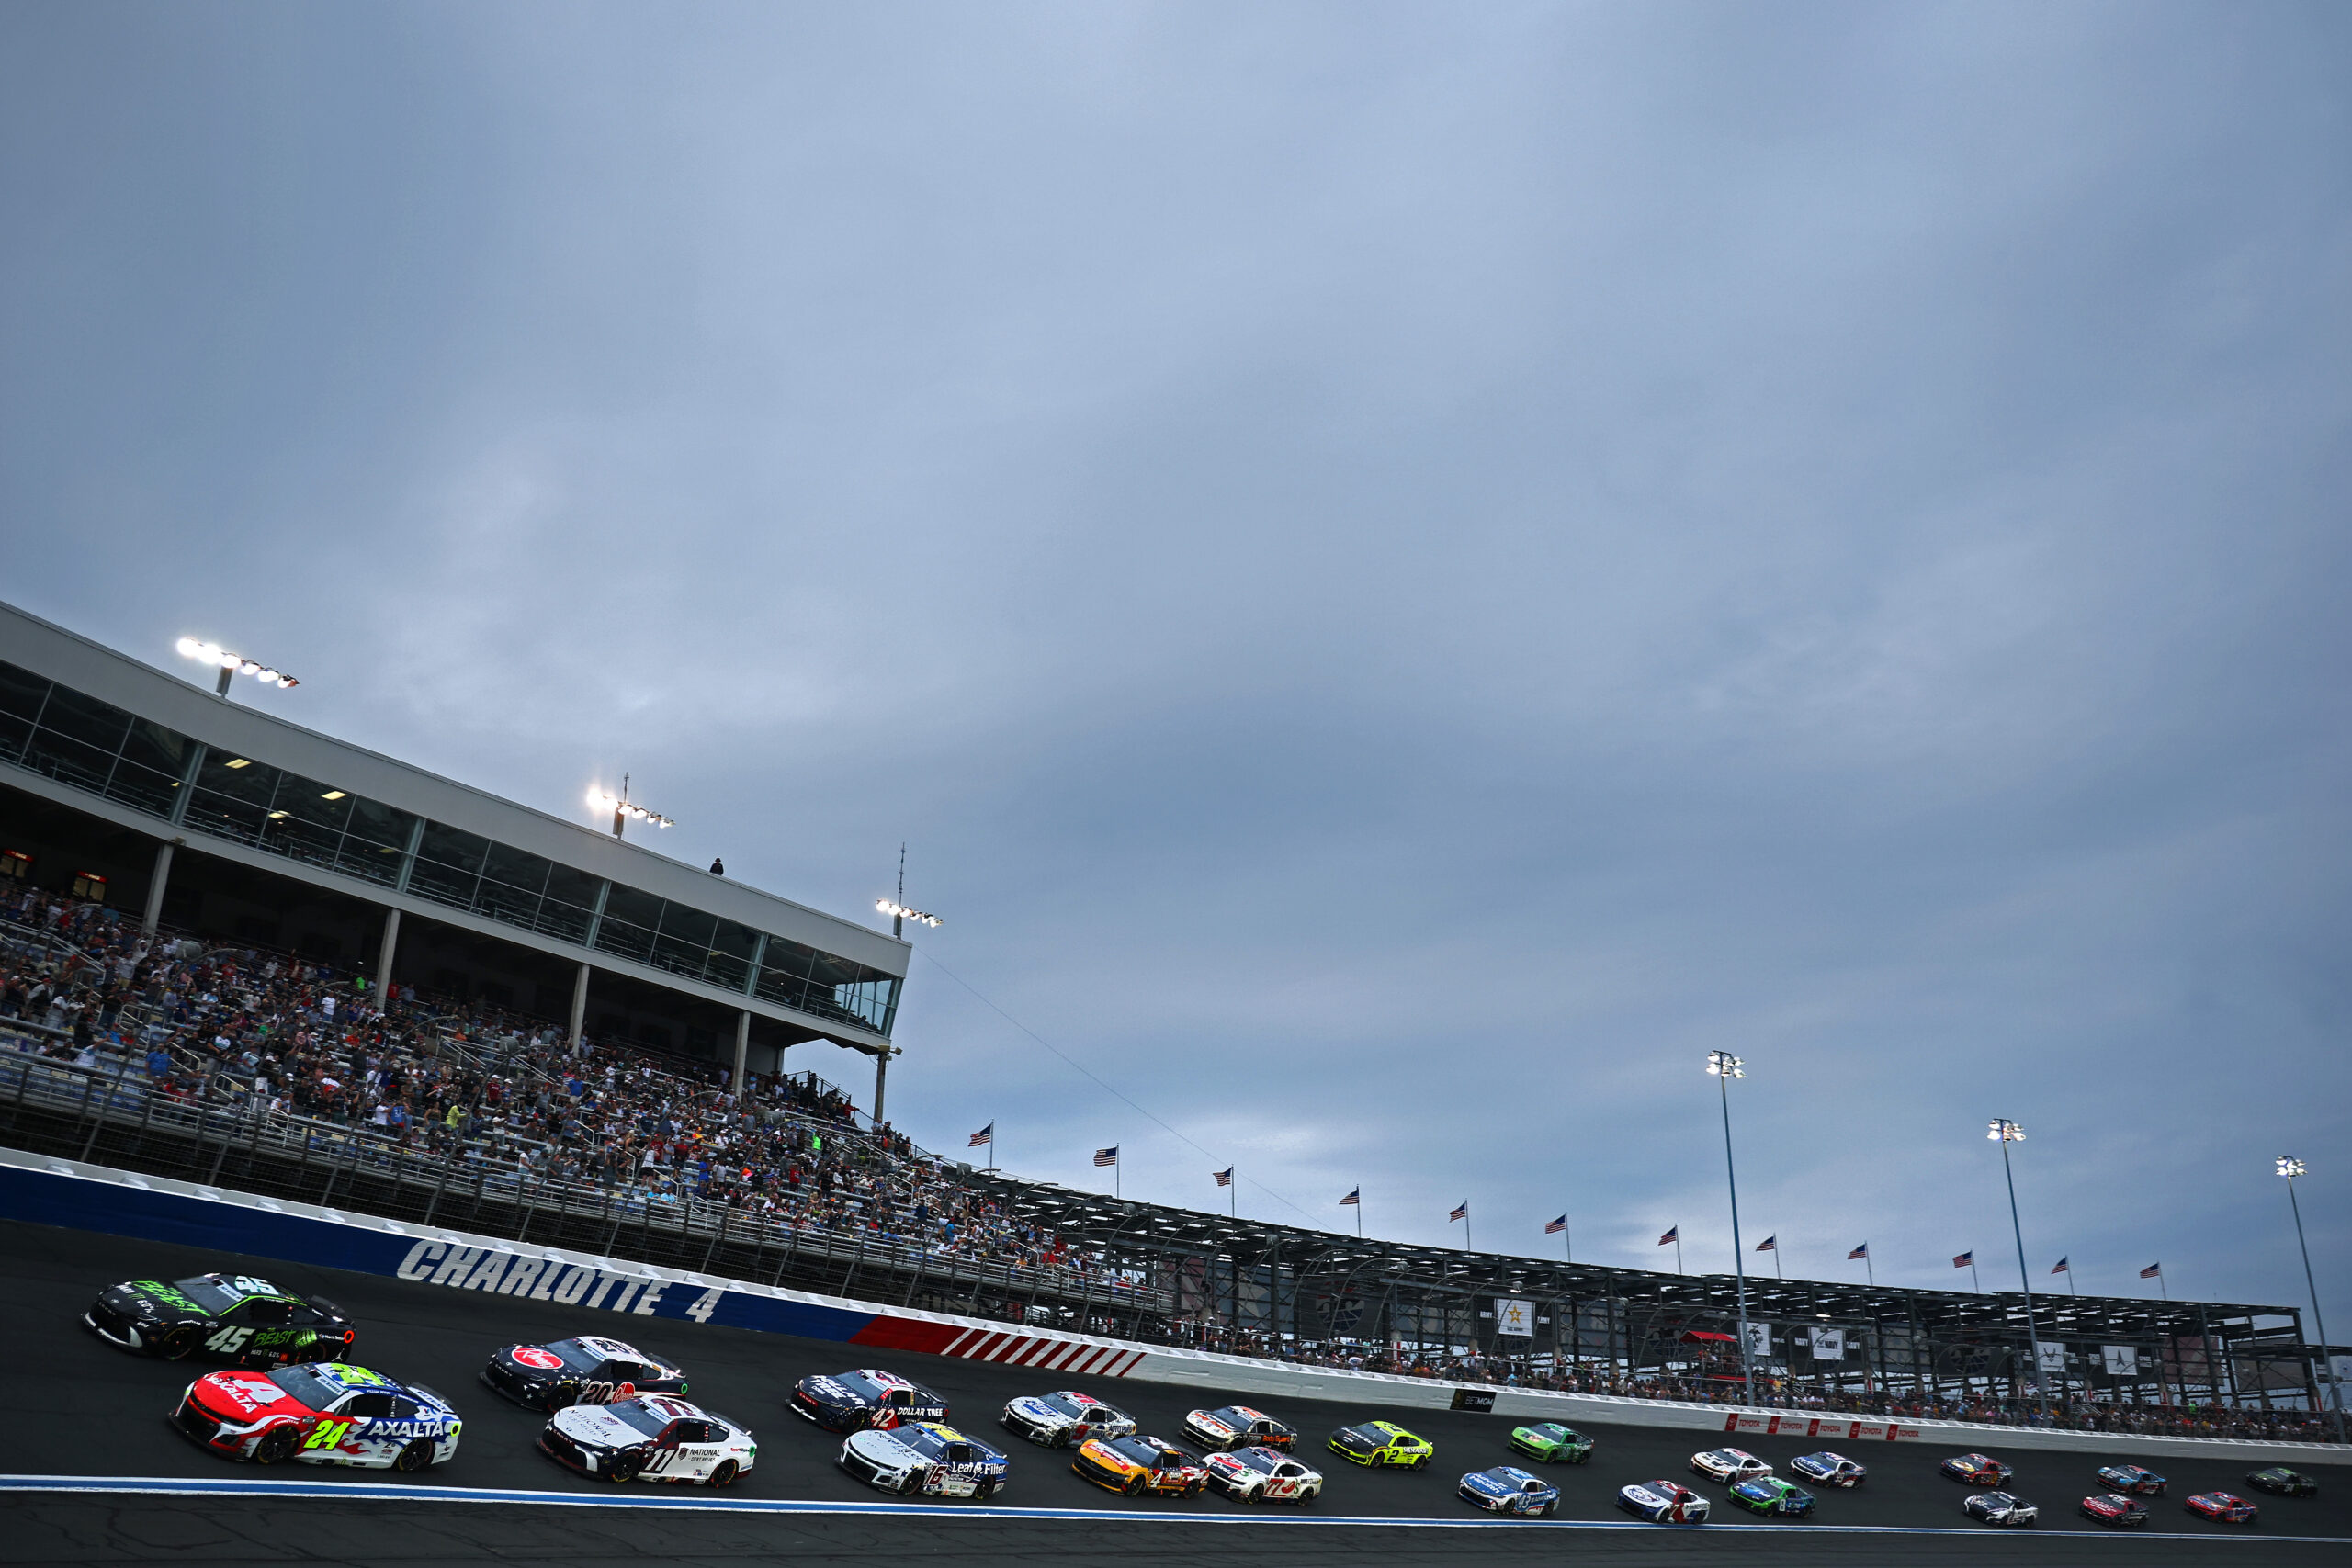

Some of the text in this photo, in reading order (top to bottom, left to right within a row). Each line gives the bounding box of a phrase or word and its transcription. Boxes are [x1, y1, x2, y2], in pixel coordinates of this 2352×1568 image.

[234, 1275, 279, 1296] 45
[396, 1238, 724, 1324] CHARLOTTE 4
[204, 1325, 256, 1353] 45
[252, 1331, 297, 1348] BEAST
[579, 1381, 614, 1406] 20
[1464, 1395, 1494, 1406] BETMGM
[872, 1408, 896, 1427] 42
[897, 1406, 943, 1417] DOLLAR TREE
[368, 1420, 444, 1438] AXALTA
[1738, 1418, 1761, 1427] TOYOTA
[1781, 1422, 1803, 1430] TOYOTA
[1820, 1425, 1841, 1433] TOYOTA
[303, 1419, 351, 1450] 24
[1072, 1424, 1090, 1440] 9
[1860, 1427, 1883, 1435] TOYOTA
[1898, 1429, 1919, 1438] TOYOTA
[644, 1448, 676, 1473] 11
[689, 1448, 720, 1457] NATIONAL
[1386, 1450, 1400, 1462] 2
[923, 1464, 949, 1485] 16
[951, 1461, 1006, 1475] Leaf Filter
[1149, 1470, 1164, 1488] 4
[1264, 1478, 1285, 1496] 77
[1518, 1495, 1532, 1509] 43
[1779, 1498, 1787, 1512] 8
